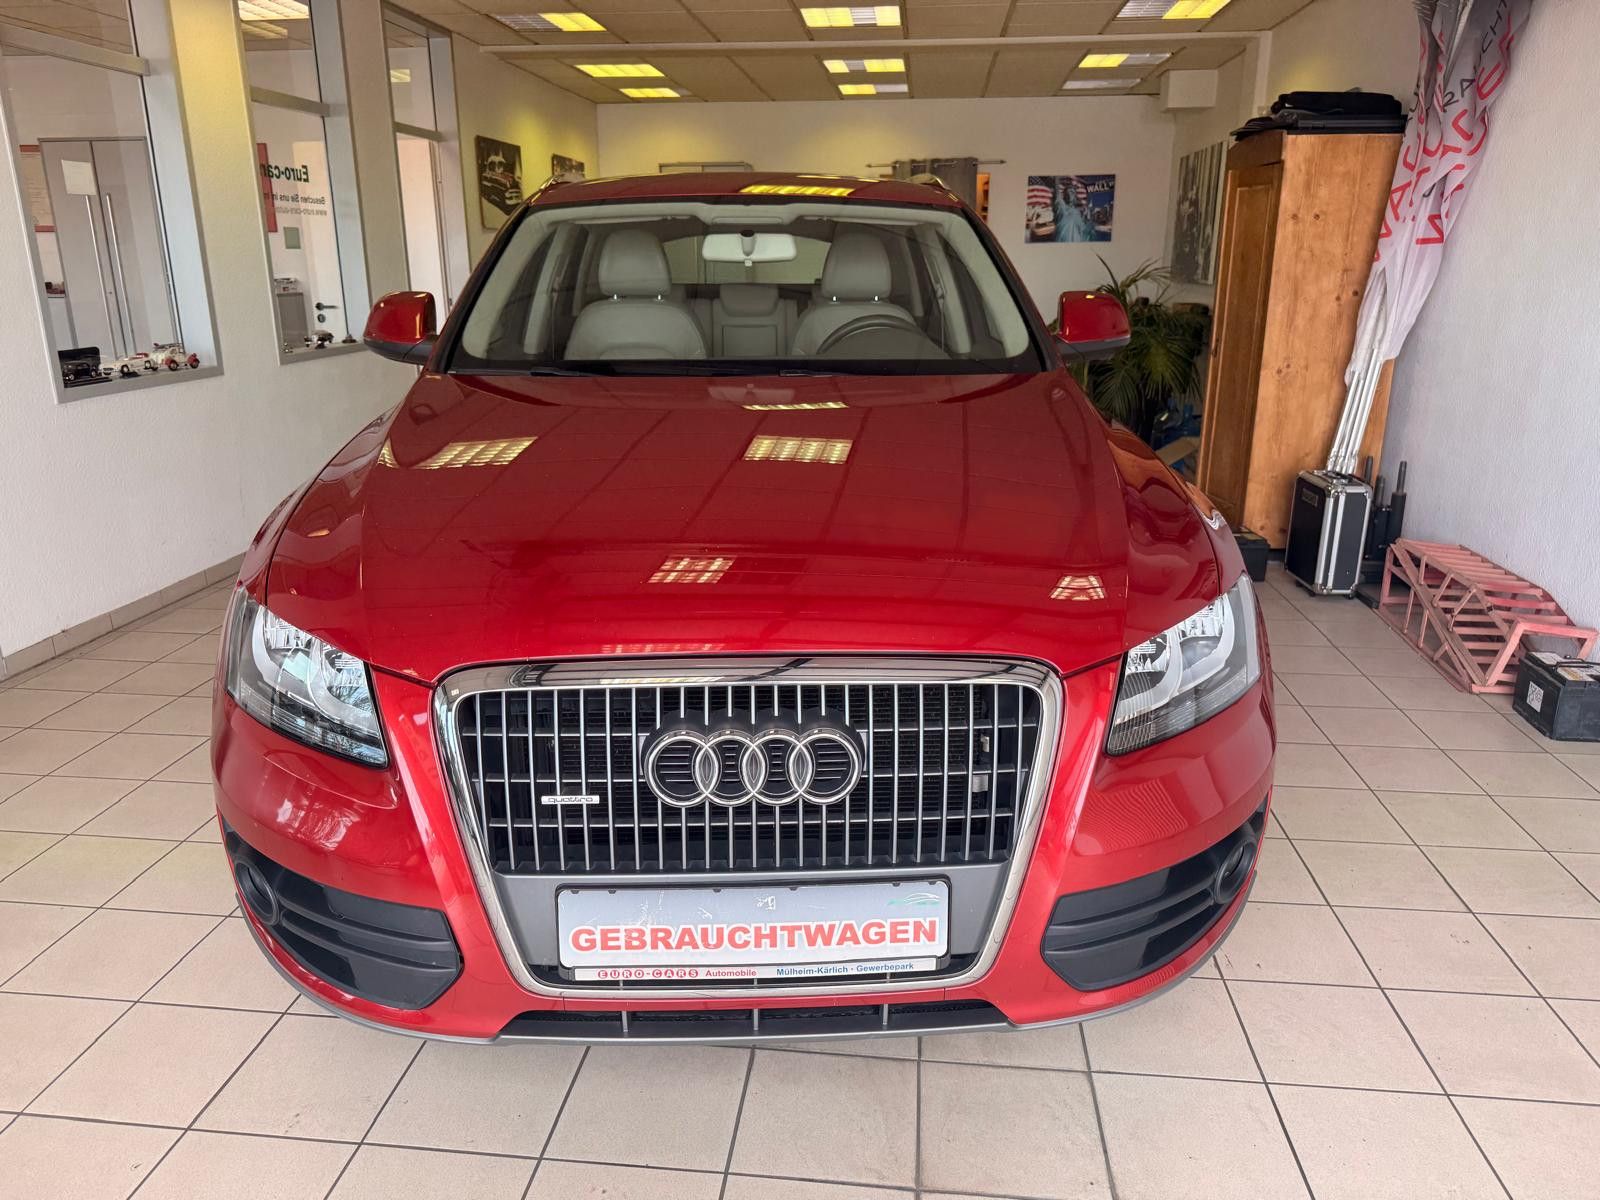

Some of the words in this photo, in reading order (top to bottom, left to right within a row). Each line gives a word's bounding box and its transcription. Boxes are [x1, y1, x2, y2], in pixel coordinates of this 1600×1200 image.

[1086, 181, 1109, 192] WALL
[570, 919, 938, 953] GEBRAUCHTWAGEN
[597, 969, 699, 979] EURO-CARS
[705, 969, 757, 978] Automobile
[776, 966, 848, 976] Mülheim-Kärlich
[856, 962, 914, 973] Gewerbepark
